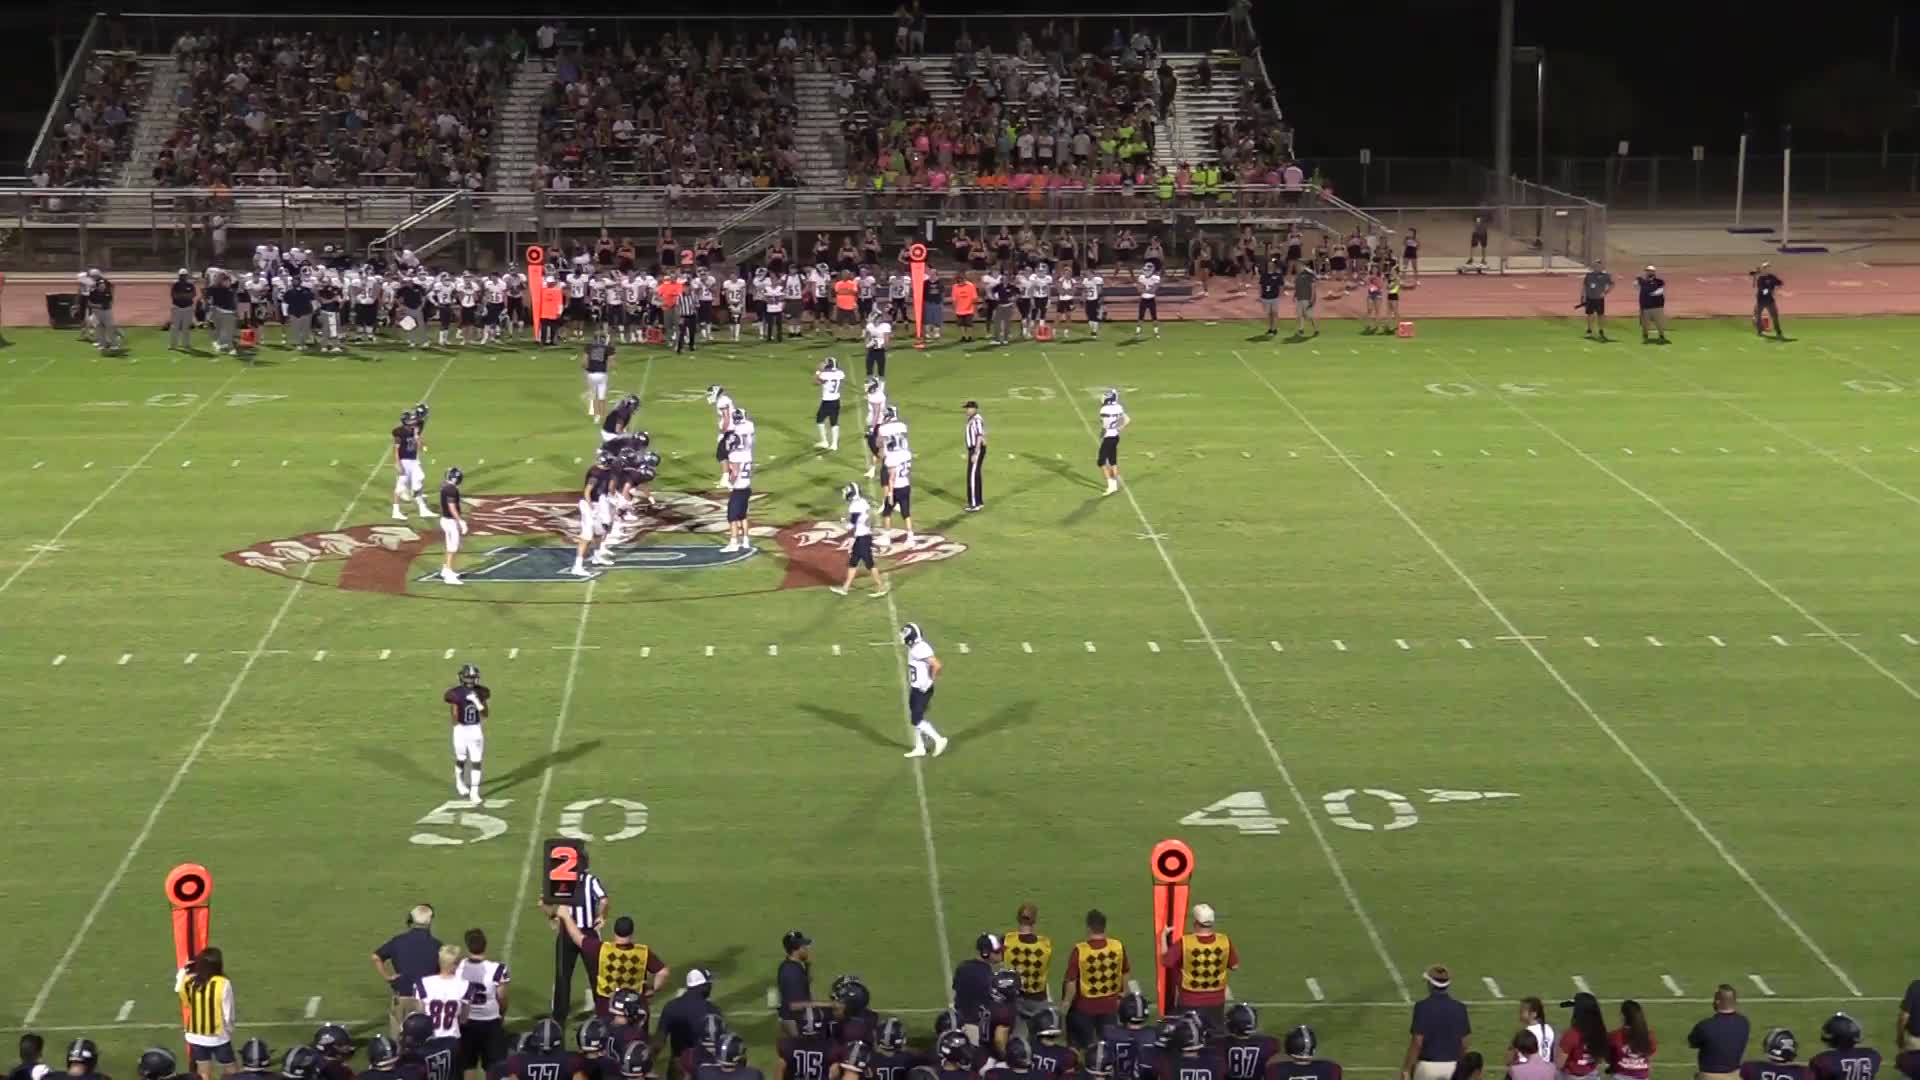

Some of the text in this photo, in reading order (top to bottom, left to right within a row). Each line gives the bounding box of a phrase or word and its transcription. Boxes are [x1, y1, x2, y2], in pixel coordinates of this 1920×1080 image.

[680, 249, 695, 265] 2
[408, 798, 648, 844] 50
[1178, 788, 1419, 834] 40
[549, 846, 579, 881] 2
[429, 999, 458, 1030] 88
[793, 1049, 824, 1080] 15
[1228, 1046, 1260, 1079] 87
[1840, 1057, 1872, 1080] 76
